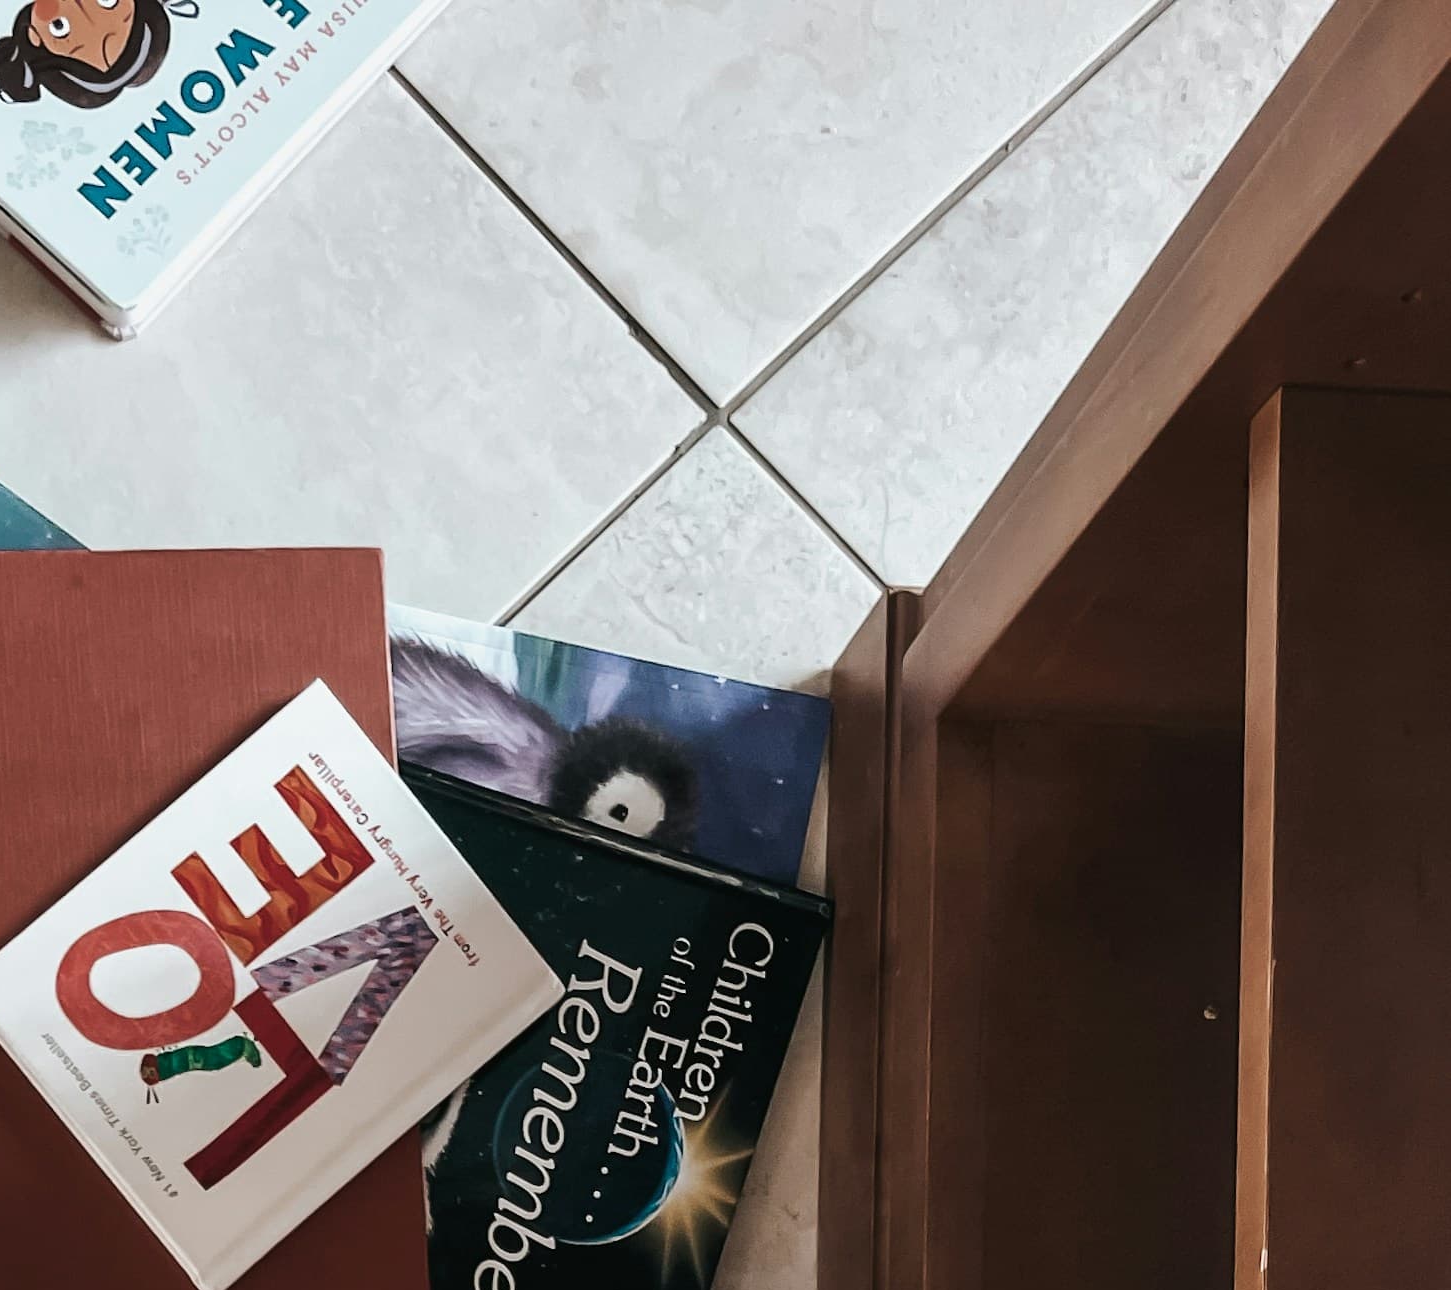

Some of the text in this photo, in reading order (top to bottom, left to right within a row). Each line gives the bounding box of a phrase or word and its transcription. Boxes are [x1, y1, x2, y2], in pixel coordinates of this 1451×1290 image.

[270, 45, 318, 88] MAY
[76, 28, 276, 220] WOMEN
[175, 92, 272, 186] ALCOTT'S
[306, 749, 481, 968] from The Very Hungry Caterpillar
[668, 936, 699, 970] of
[651, 973, 689, 1020] the
[672, 919, 777, 1131] Children
[39, 1031, 93, 1092] Bestseller
[87, 1090, 121, 1128] Times
[117, 1126, 143, 1156] York
[140, 1154, 166, 1182] New
